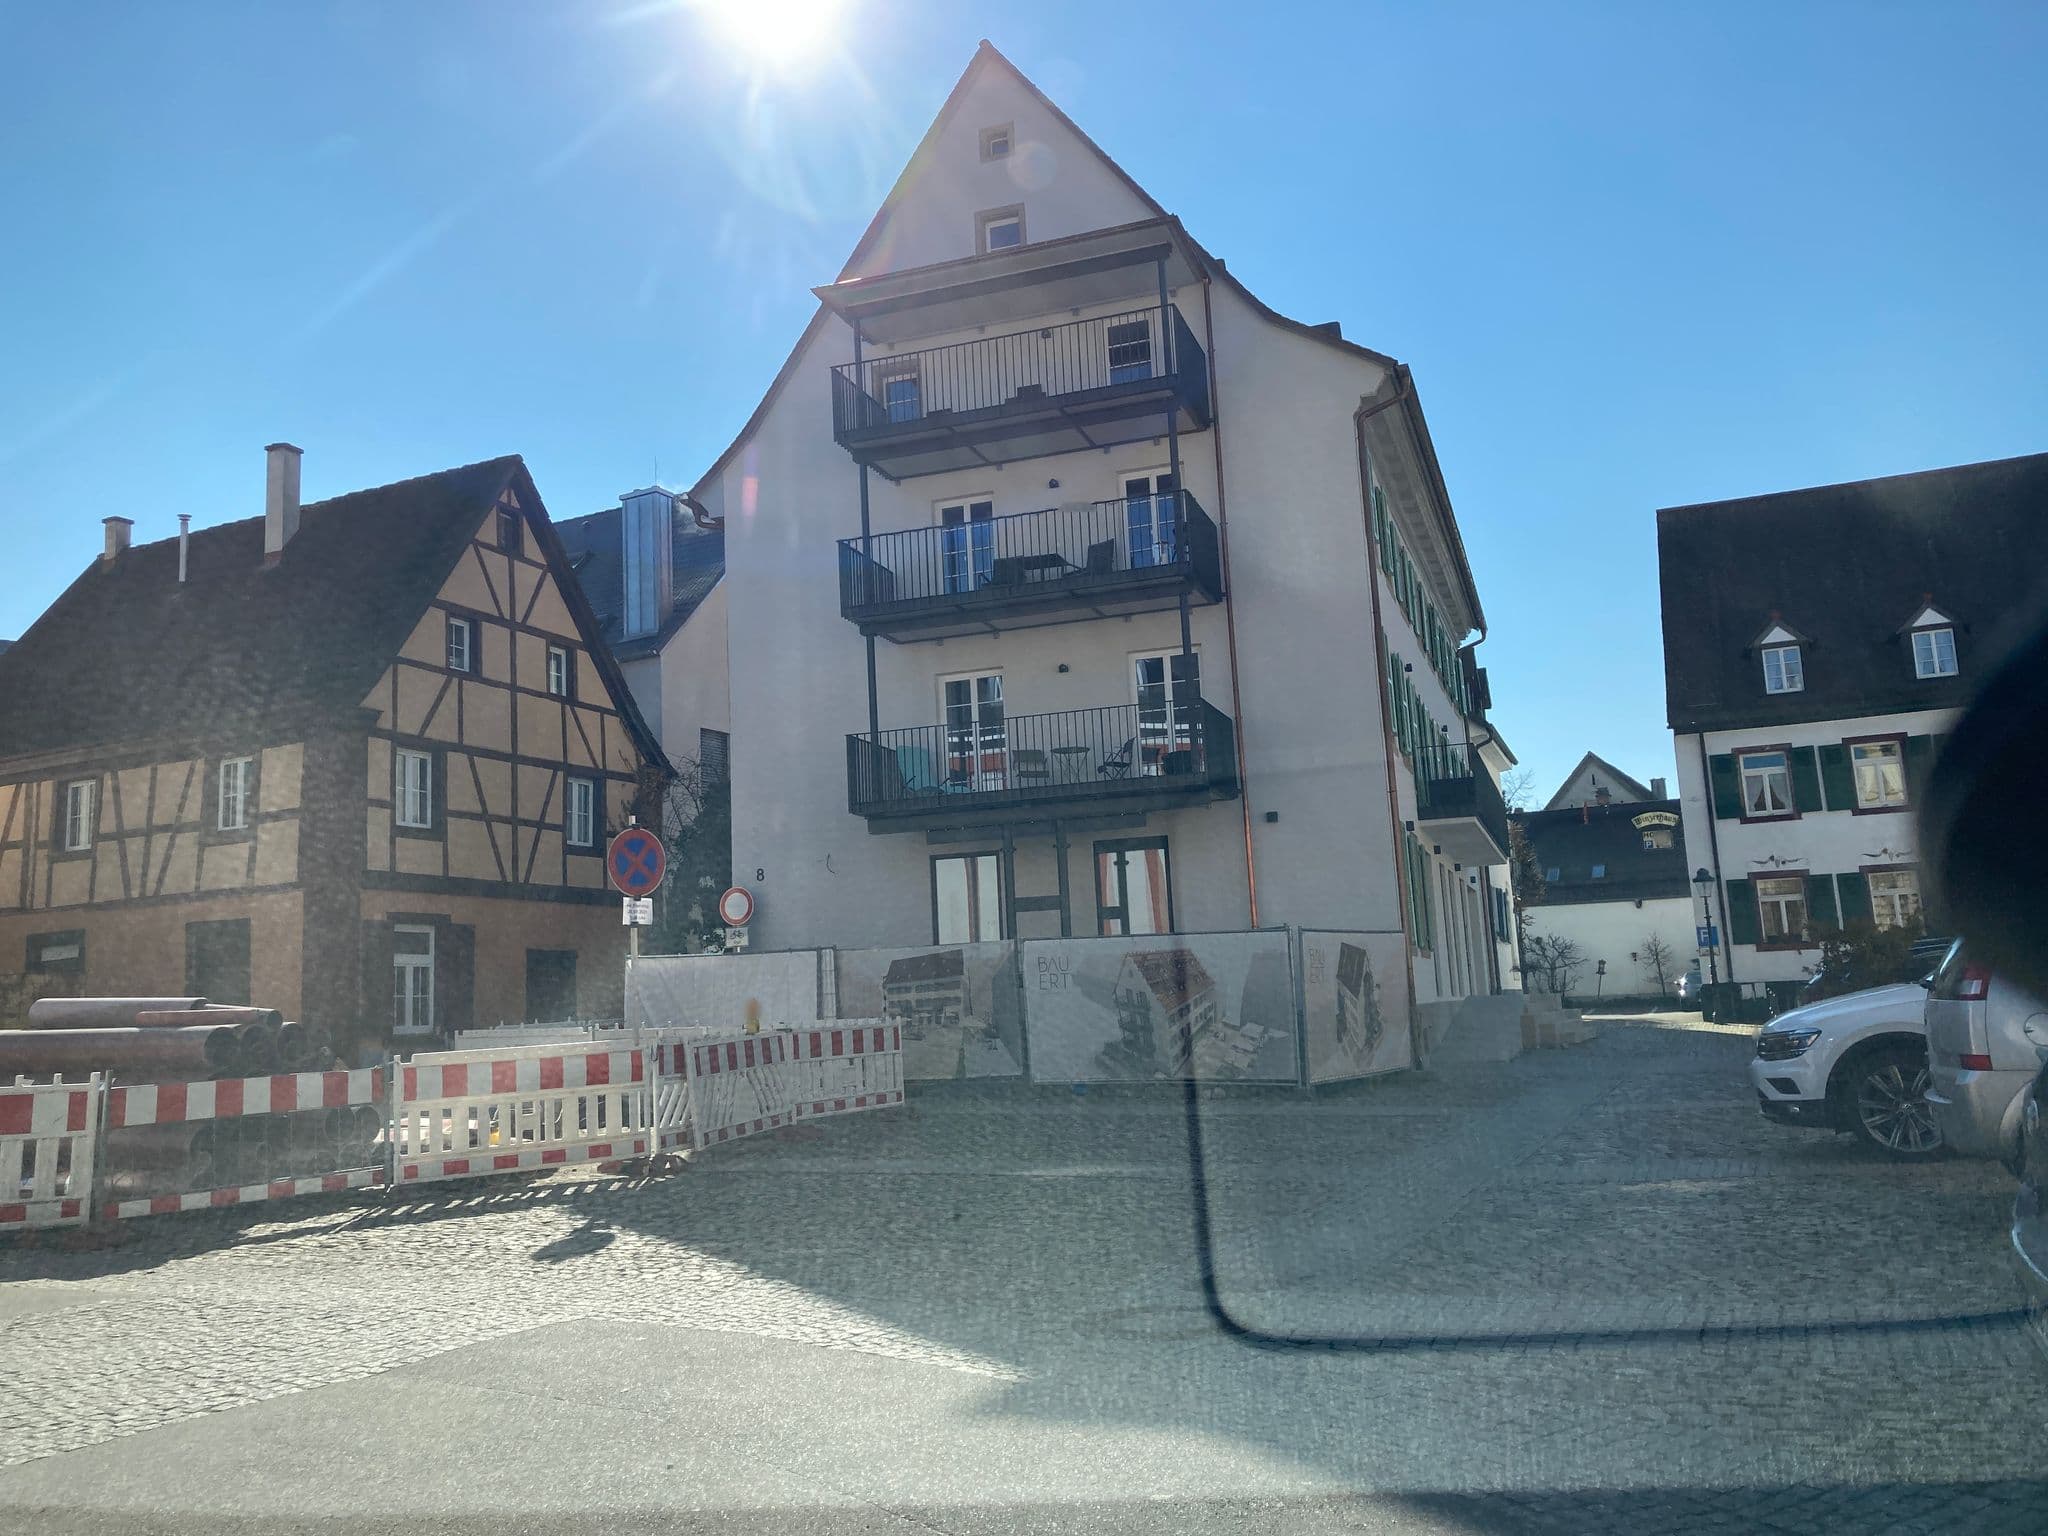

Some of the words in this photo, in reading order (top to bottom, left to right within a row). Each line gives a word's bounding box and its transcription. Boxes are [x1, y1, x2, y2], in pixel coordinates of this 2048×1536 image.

[756, 868, 765, 882] 8
[1038, 956, 1069, 973] BAU
[1039, 972, 1070, 991] ERT
